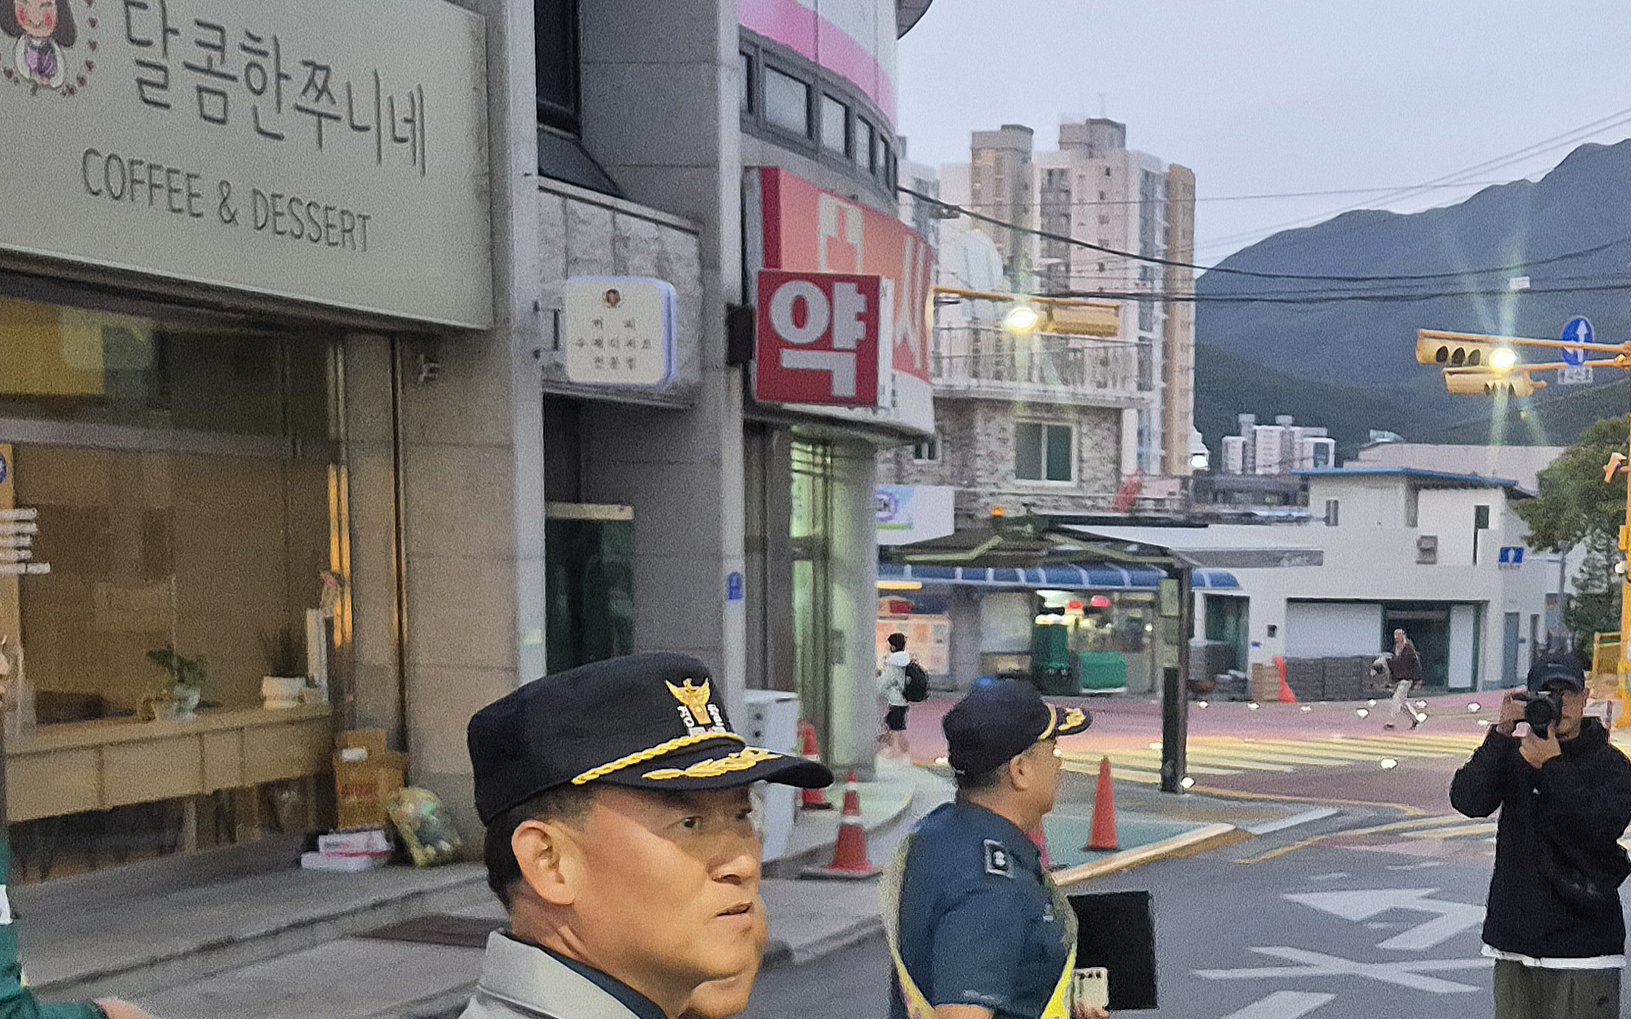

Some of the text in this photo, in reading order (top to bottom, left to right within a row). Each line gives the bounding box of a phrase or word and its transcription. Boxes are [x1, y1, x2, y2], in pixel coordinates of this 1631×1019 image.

[124, 0, 426, 175] 달콤한쭈니네
[82, 147, 372, 252] COFFEE & DESSERT
[769, 279, 868, 399] 약
